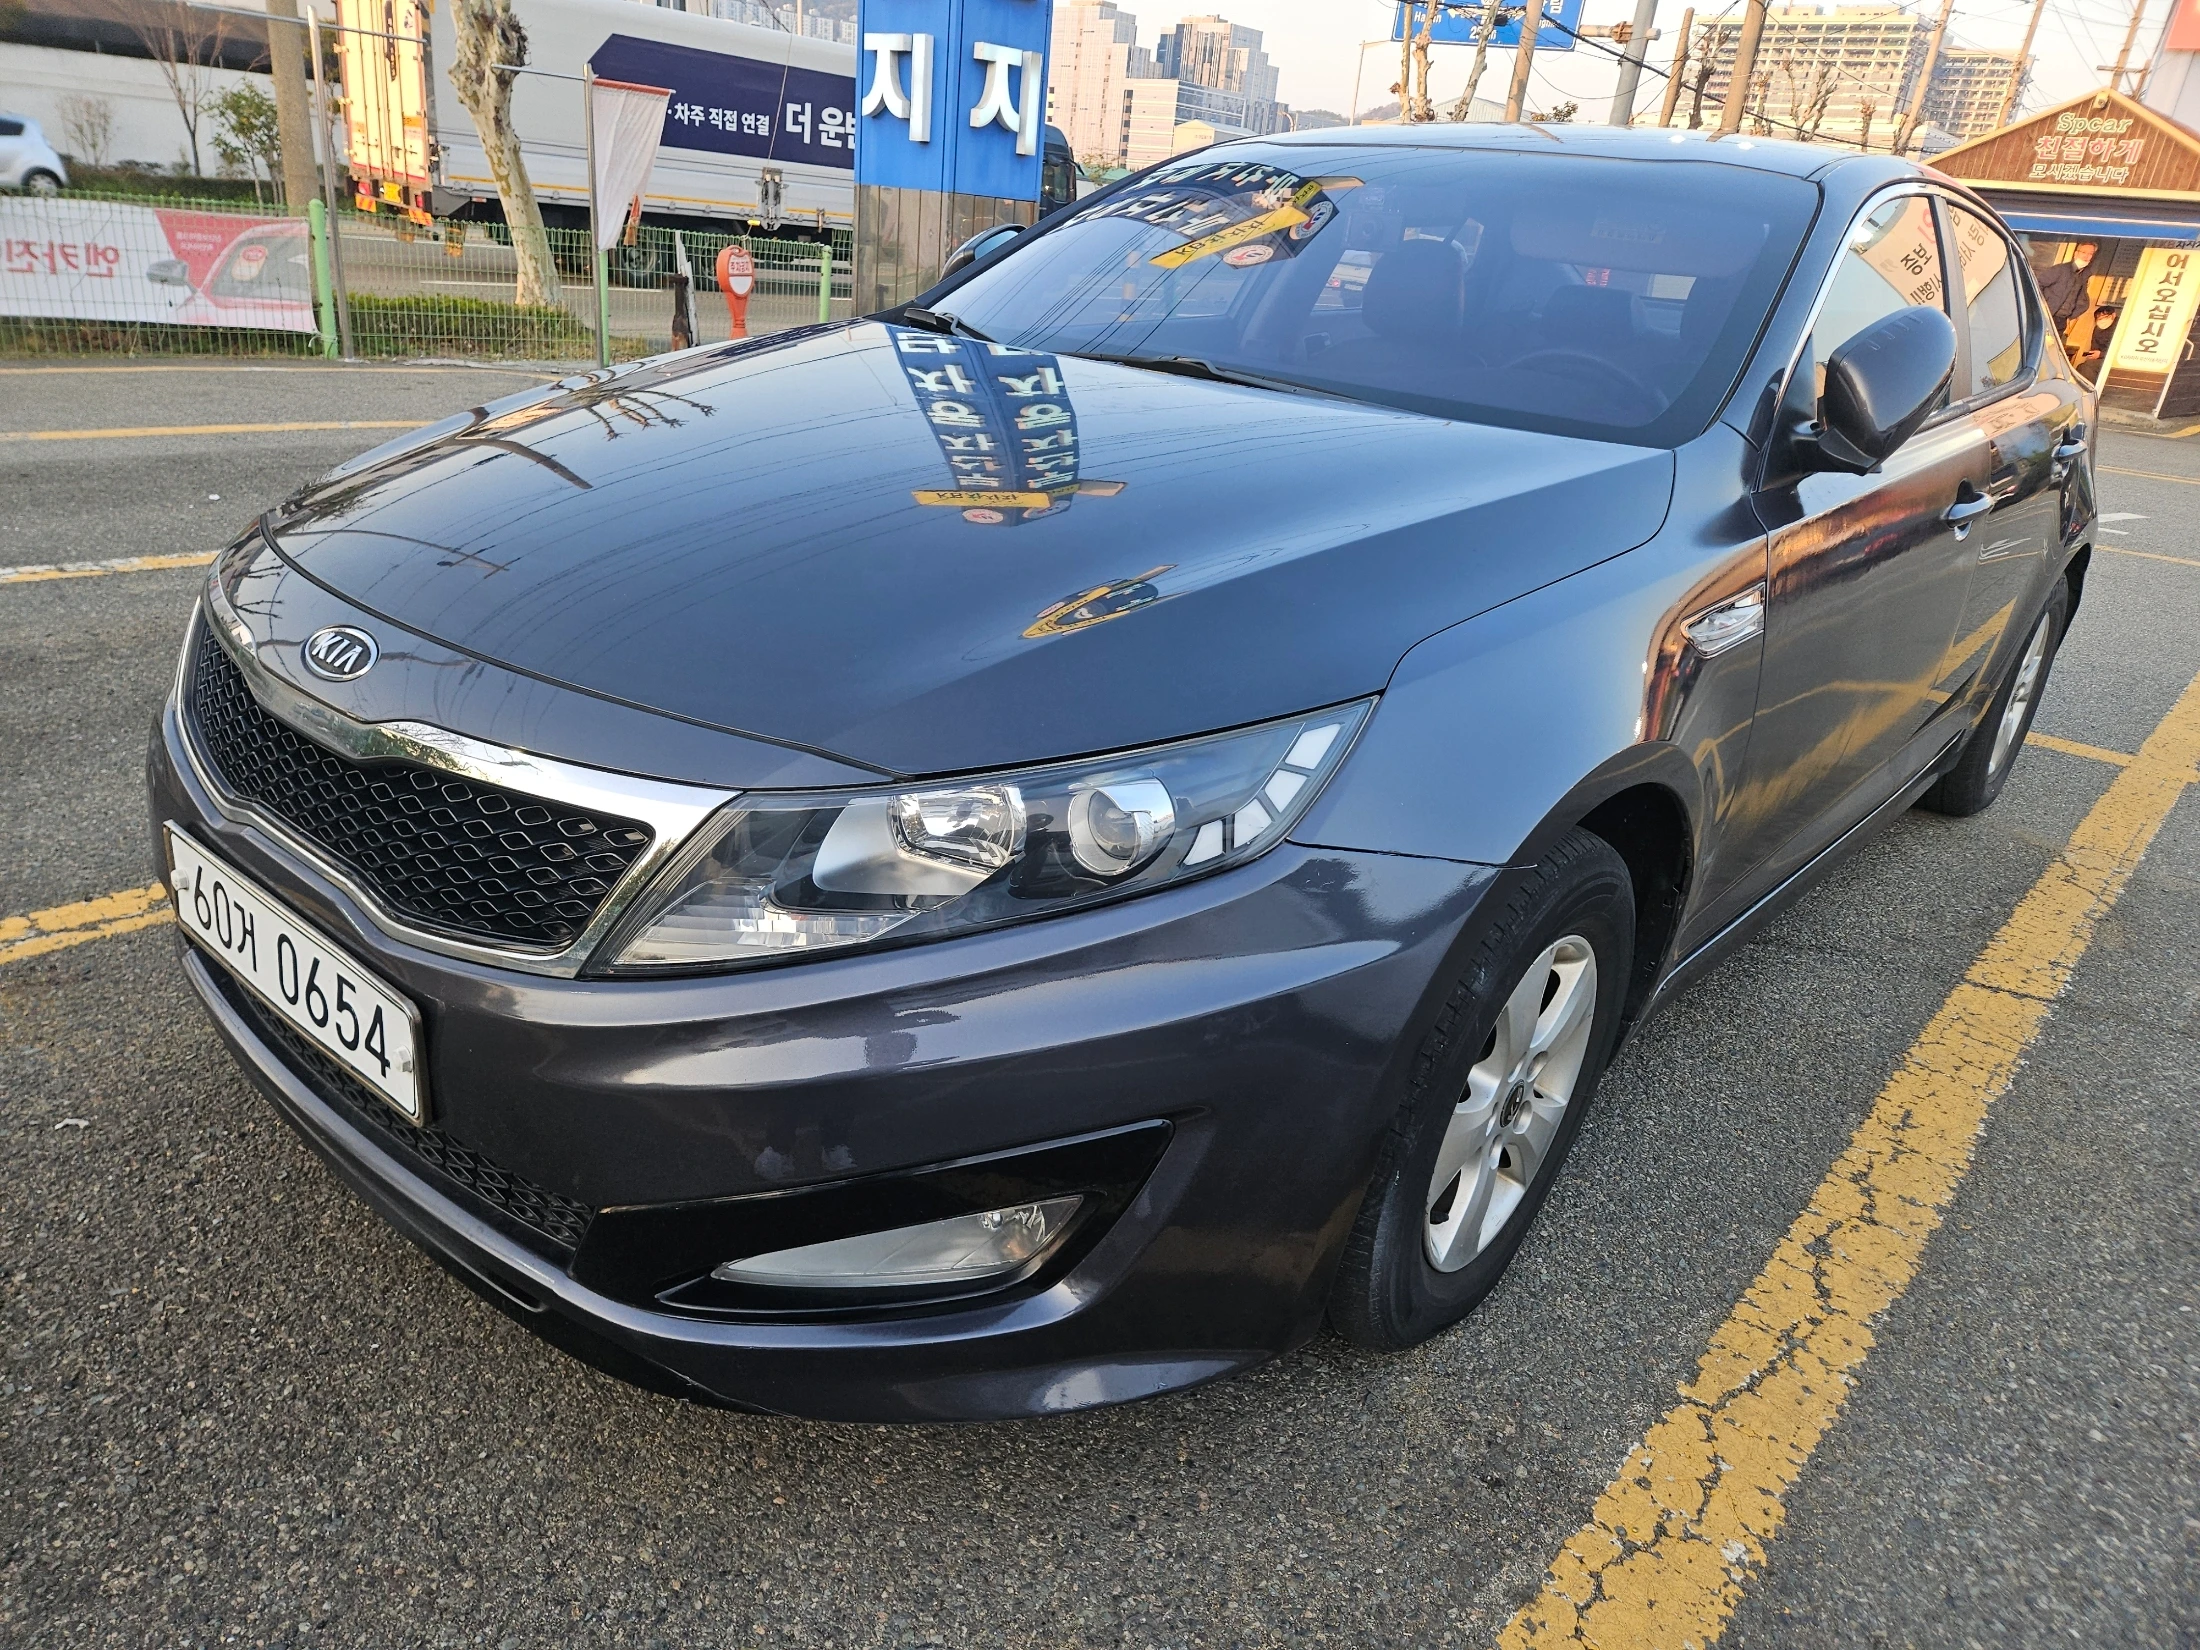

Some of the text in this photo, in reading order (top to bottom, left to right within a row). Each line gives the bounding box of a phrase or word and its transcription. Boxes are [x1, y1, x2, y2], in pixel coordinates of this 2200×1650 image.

[708, 107, 738, 132] 직접
[741, 112, 770, 136] 연결
[785, 102, 812, 144] 더
[2057, 112, 2133, 135] Spcar
[2034, 136, 2144, 164] 친절하게
[2029, 163, 2129, 184] 모시겠습니다
[2135, 253, 2190, 354] 어서오십시오
[311, 632, 363, 673] KIA
[194, 865, 391, 1079] 60거 0654
